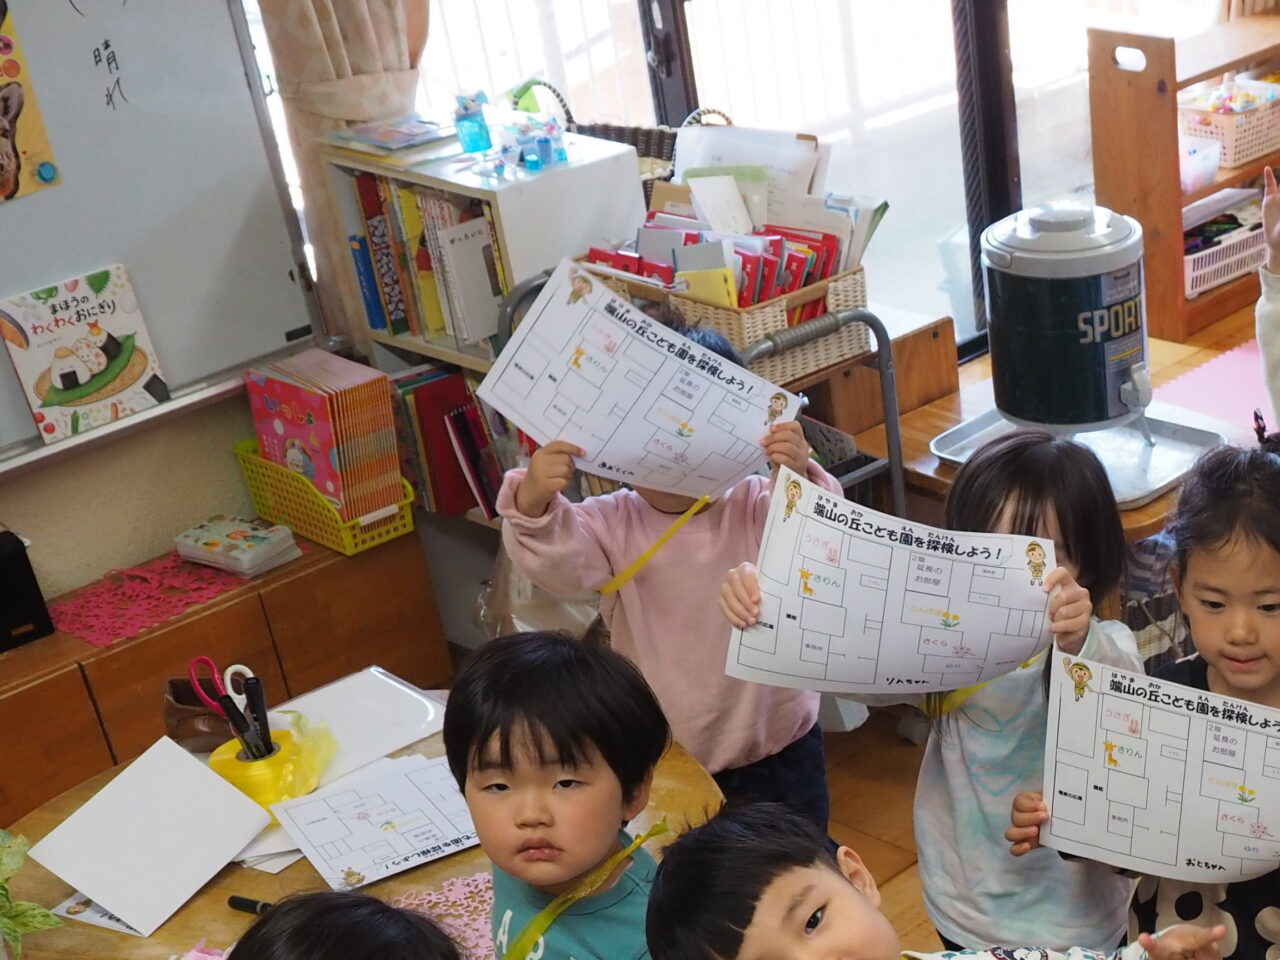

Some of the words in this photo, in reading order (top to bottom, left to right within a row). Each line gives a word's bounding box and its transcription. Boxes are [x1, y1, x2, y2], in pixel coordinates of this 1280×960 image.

[92, 39, 128, 110] 晴れ
[50, 296, 89, 315] まほうの
[31, 300, 116, 335] わくわくおにぎり
[851, 509, 863, 518] おか
[813, 501, 1002, 560] 端山の丘こども園を探検しよう！
[901, 526, 914, 534] えん
[928, 532, 955, 543] たんけん
[814, 574, 840, 588] きりん
[923, 638, 948, 647] さくら
[1111, 672, 1135, 683] はやま
[1148, 682, 1161, 690] おか
[1198, 695, 1210, 703] えん
[1222, 701, 1249, 713] たんけん
[1118, 745, 1143, 759] きりん
[1221, 813, 1245, 824] さくら
